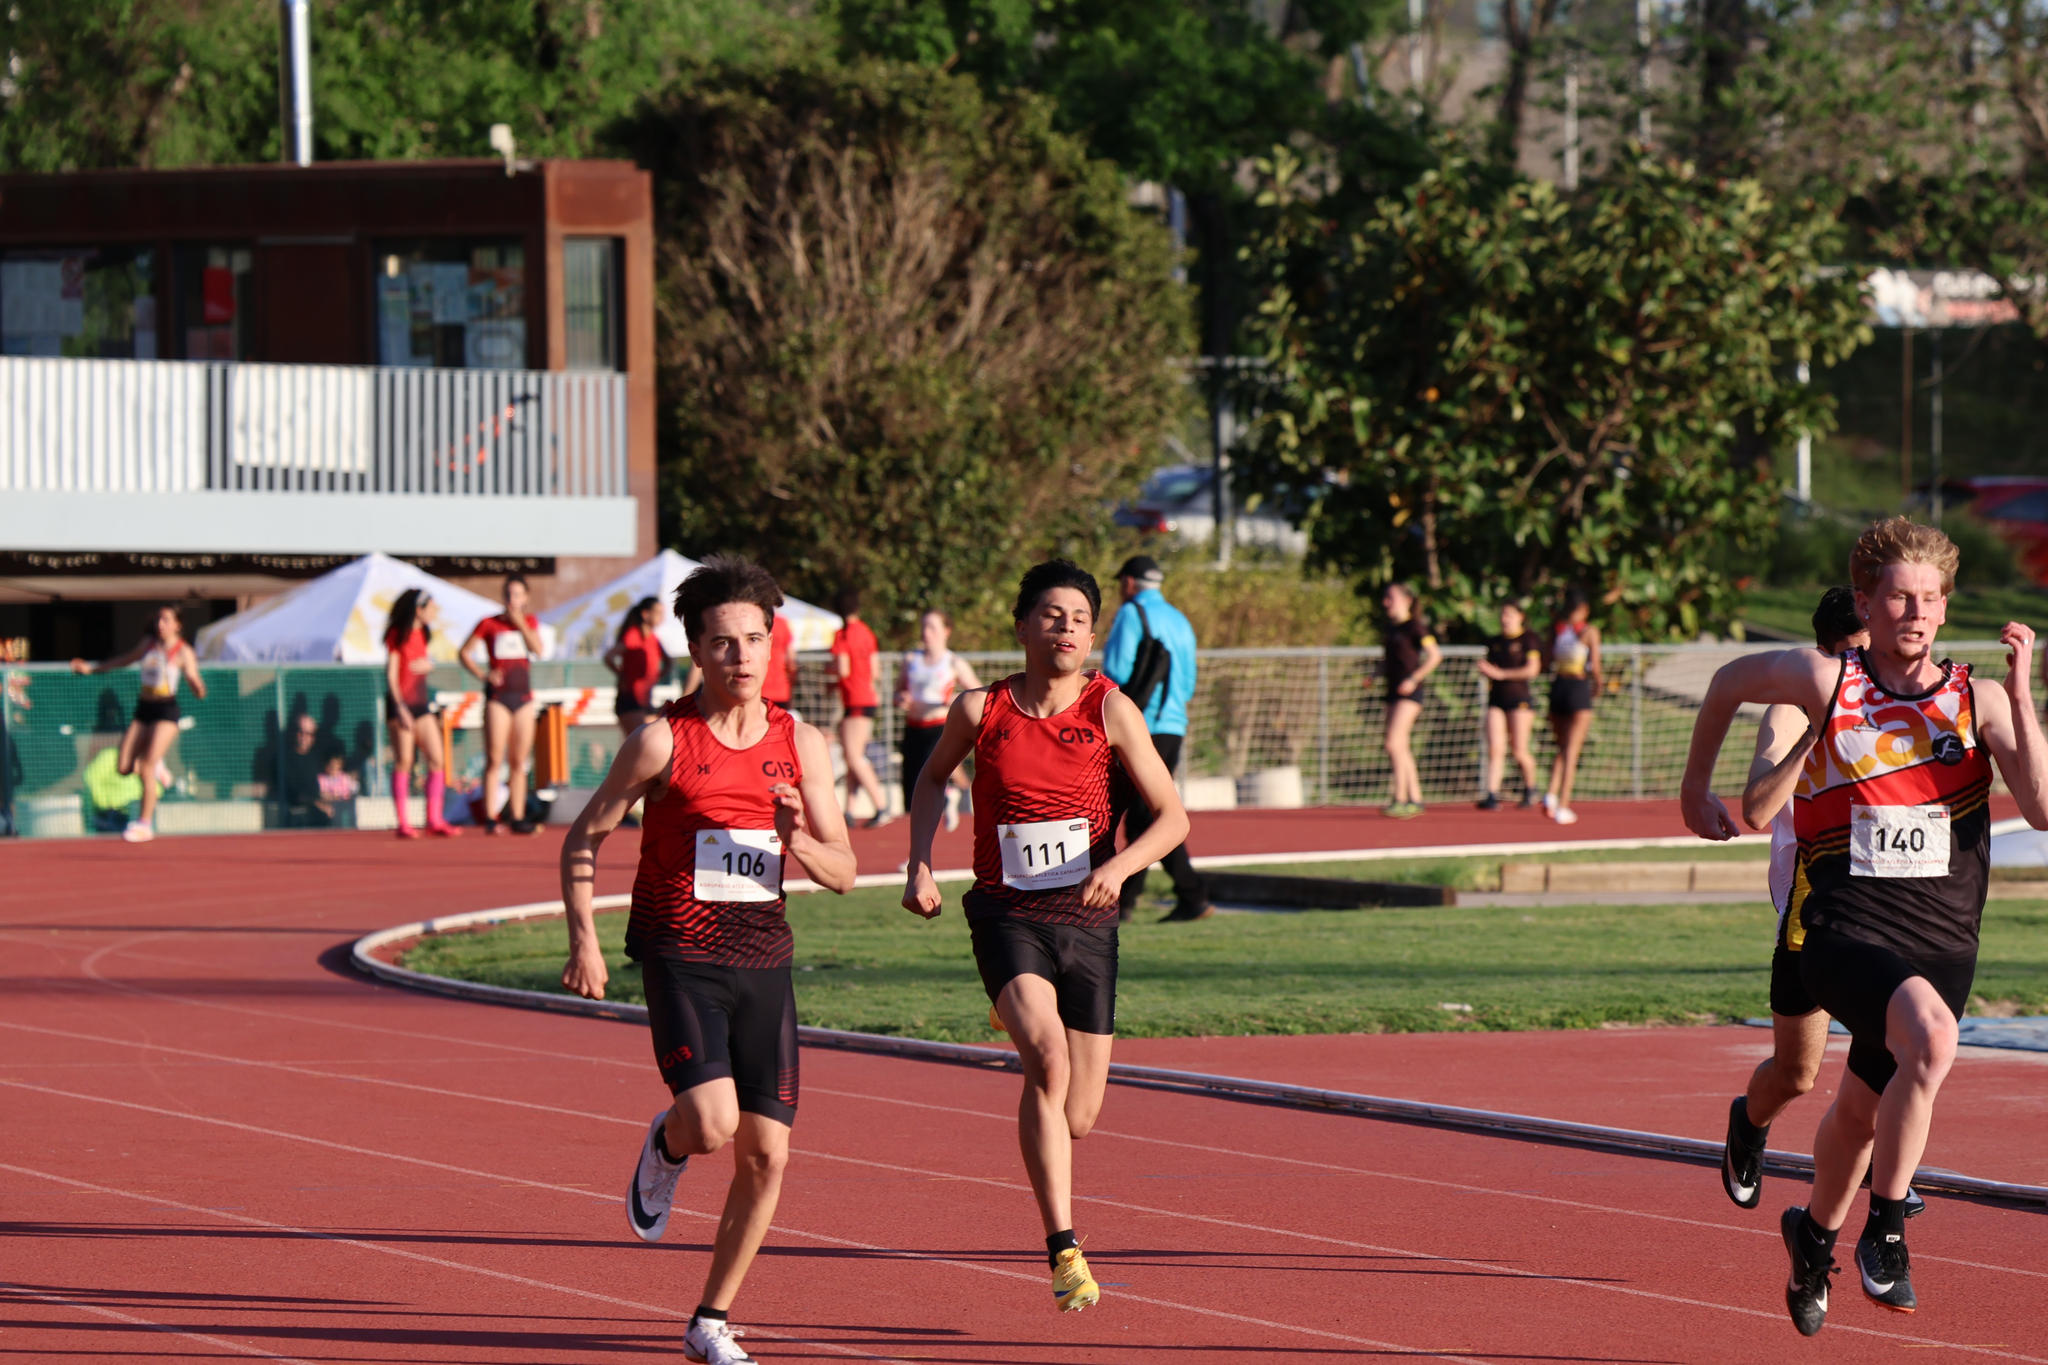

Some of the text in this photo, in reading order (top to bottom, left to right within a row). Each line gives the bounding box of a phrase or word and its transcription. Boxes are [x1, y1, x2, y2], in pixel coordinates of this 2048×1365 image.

[1876, 827, 1925, 852] 140
[722, 851, 766, 877] 106
[1023, 841, 1067, 867] 111
